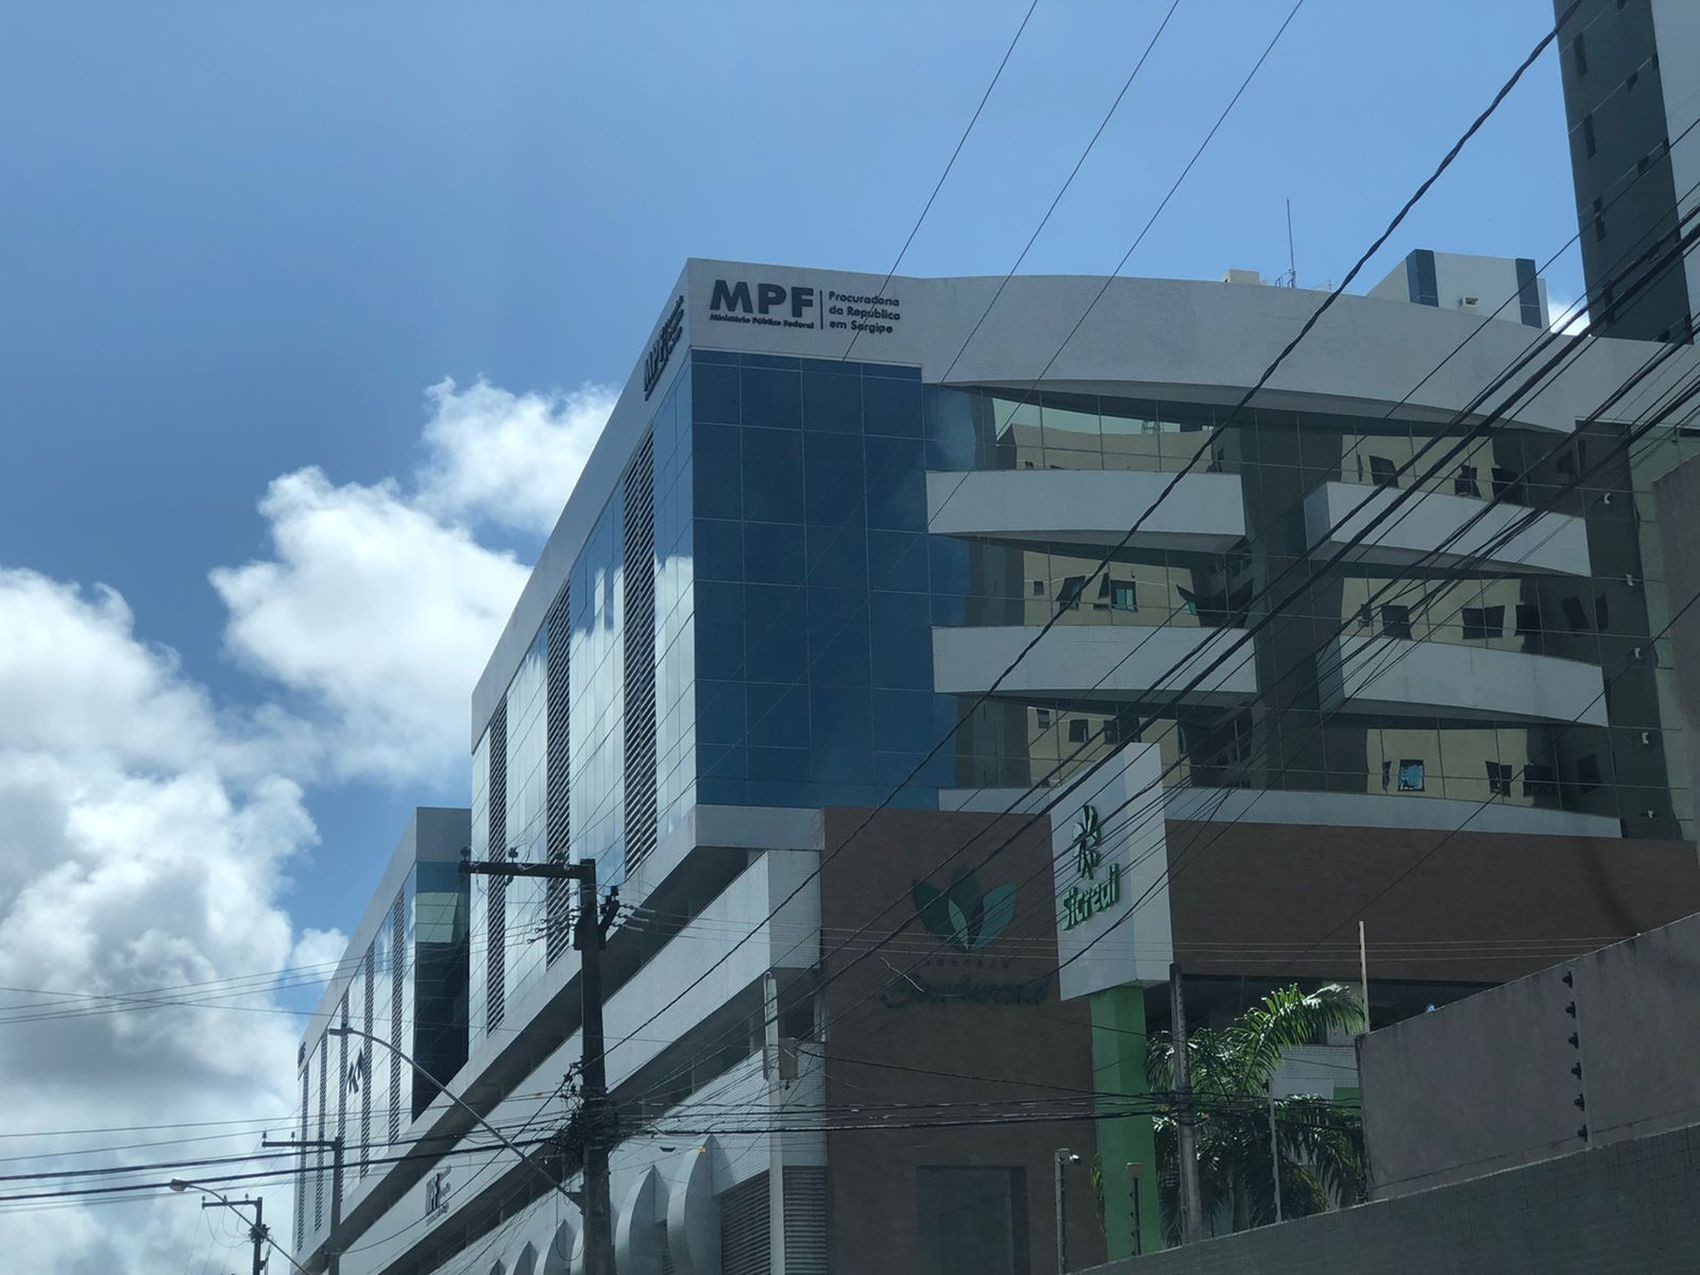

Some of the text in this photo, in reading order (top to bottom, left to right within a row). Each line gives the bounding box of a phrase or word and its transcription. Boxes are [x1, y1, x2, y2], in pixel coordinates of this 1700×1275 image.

[709, 279, 814, 318] MPF
[828, 290, 900, 307] Procuradoria
[828, 305, 901, 321] da República
[829, 320, 894, 334] em Sergipe
